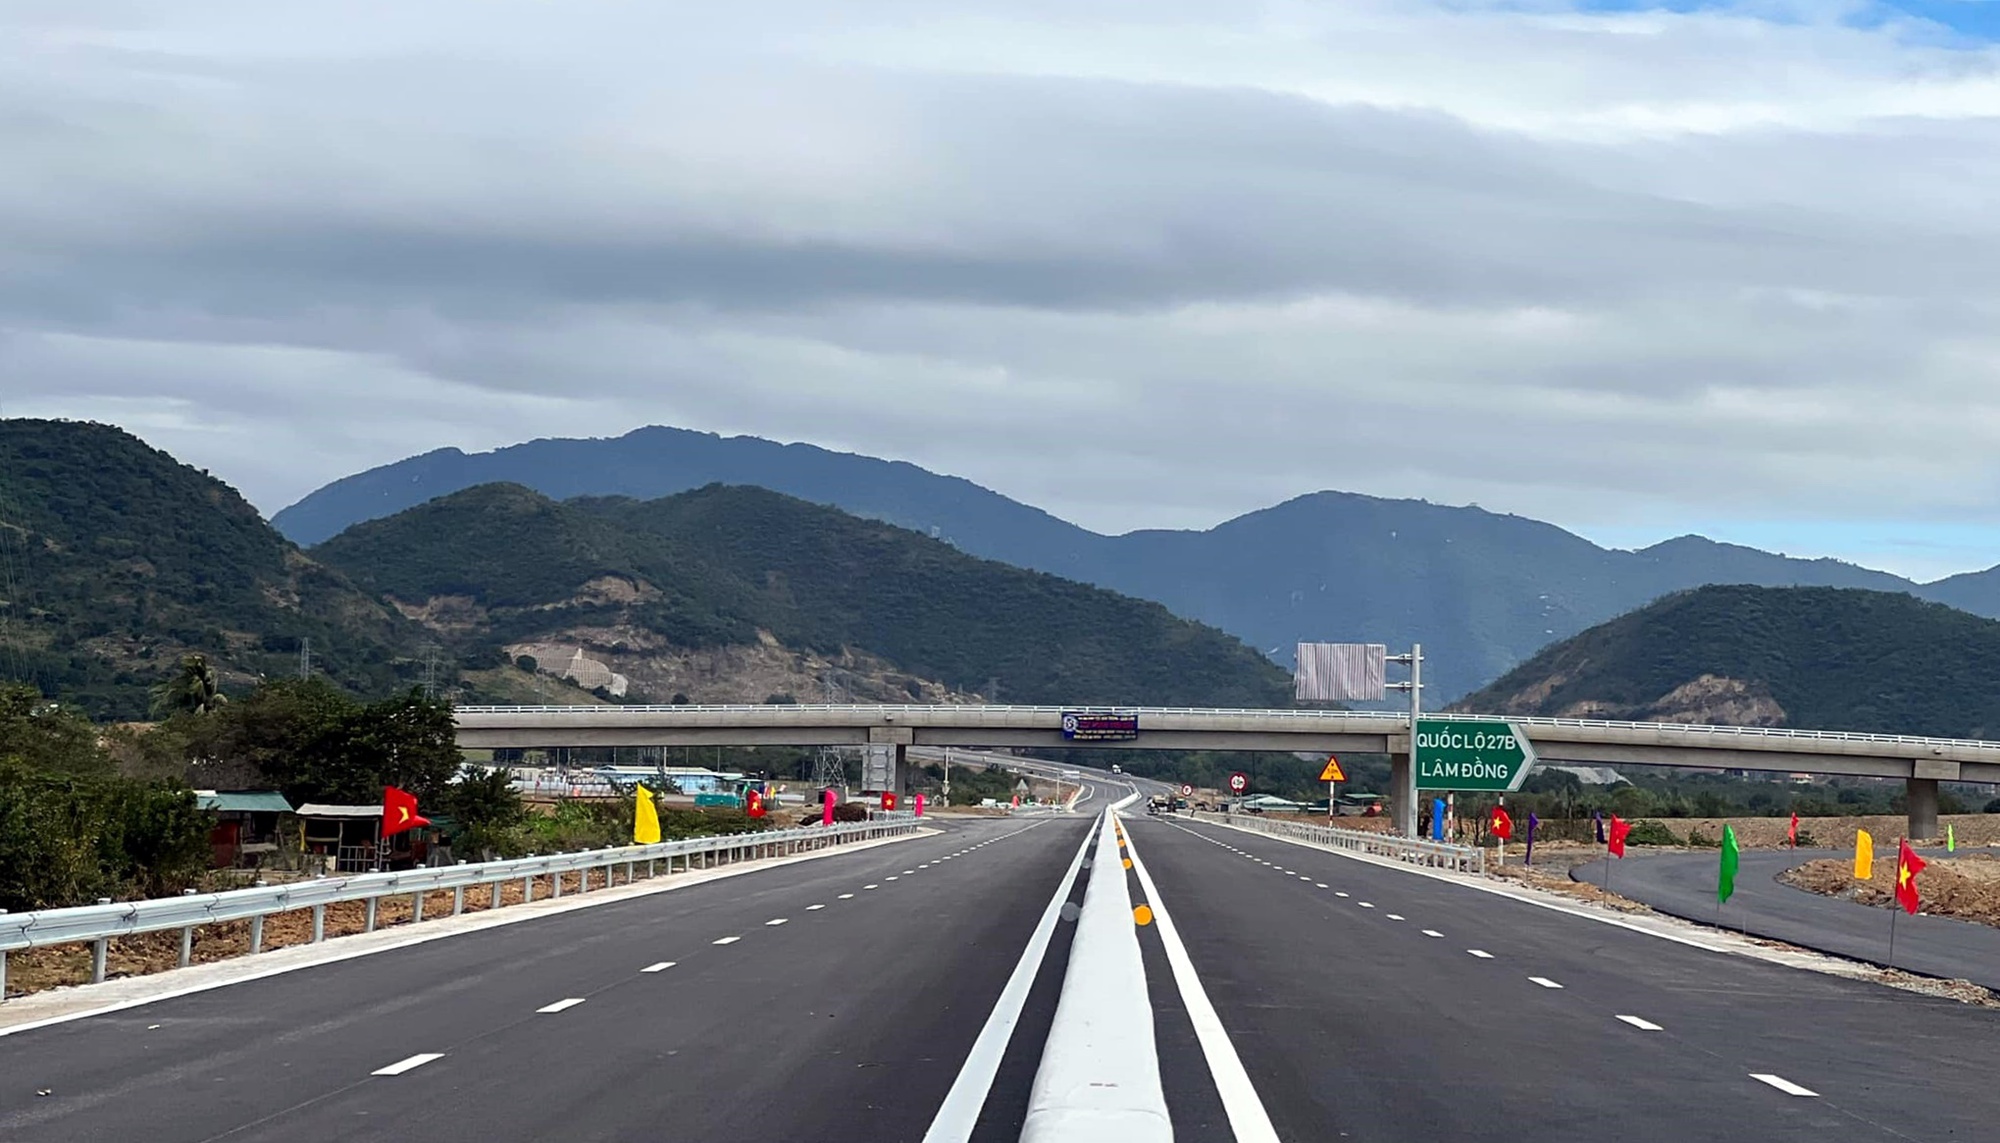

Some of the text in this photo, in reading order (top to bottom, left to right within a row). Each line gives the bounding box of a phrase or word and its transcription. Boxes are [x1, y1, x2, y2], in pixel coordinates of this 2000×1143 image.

[1417, 726, 1462, 749] QUỐC
[1421, 756, 1508, 779] LÂM ĐỒNG
